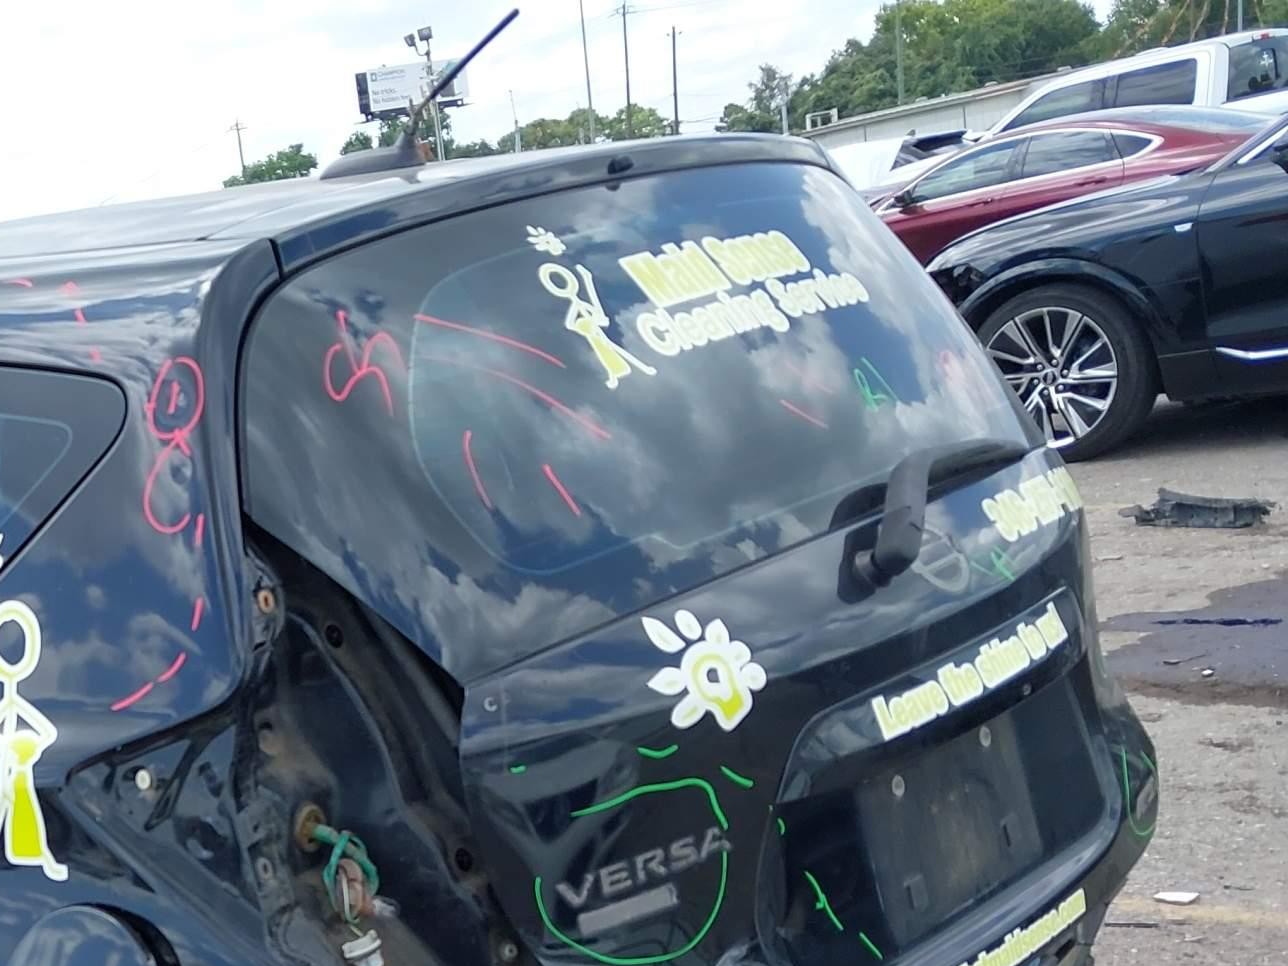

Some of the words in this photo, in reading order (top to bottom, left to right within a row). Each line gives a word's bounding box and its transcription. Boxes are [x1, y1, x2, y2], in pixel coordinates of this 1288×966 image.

[618, 240, 732, 308] Maid
[701, 230, 810, 285] Sense
[637, 290, 790, 355] Cleaning
[765, 268, 869, 318] Service
[872, 695, 949, 741] Leave
[937, 662, 984, 706] the
[555, 827, 732, 908] VERSA
